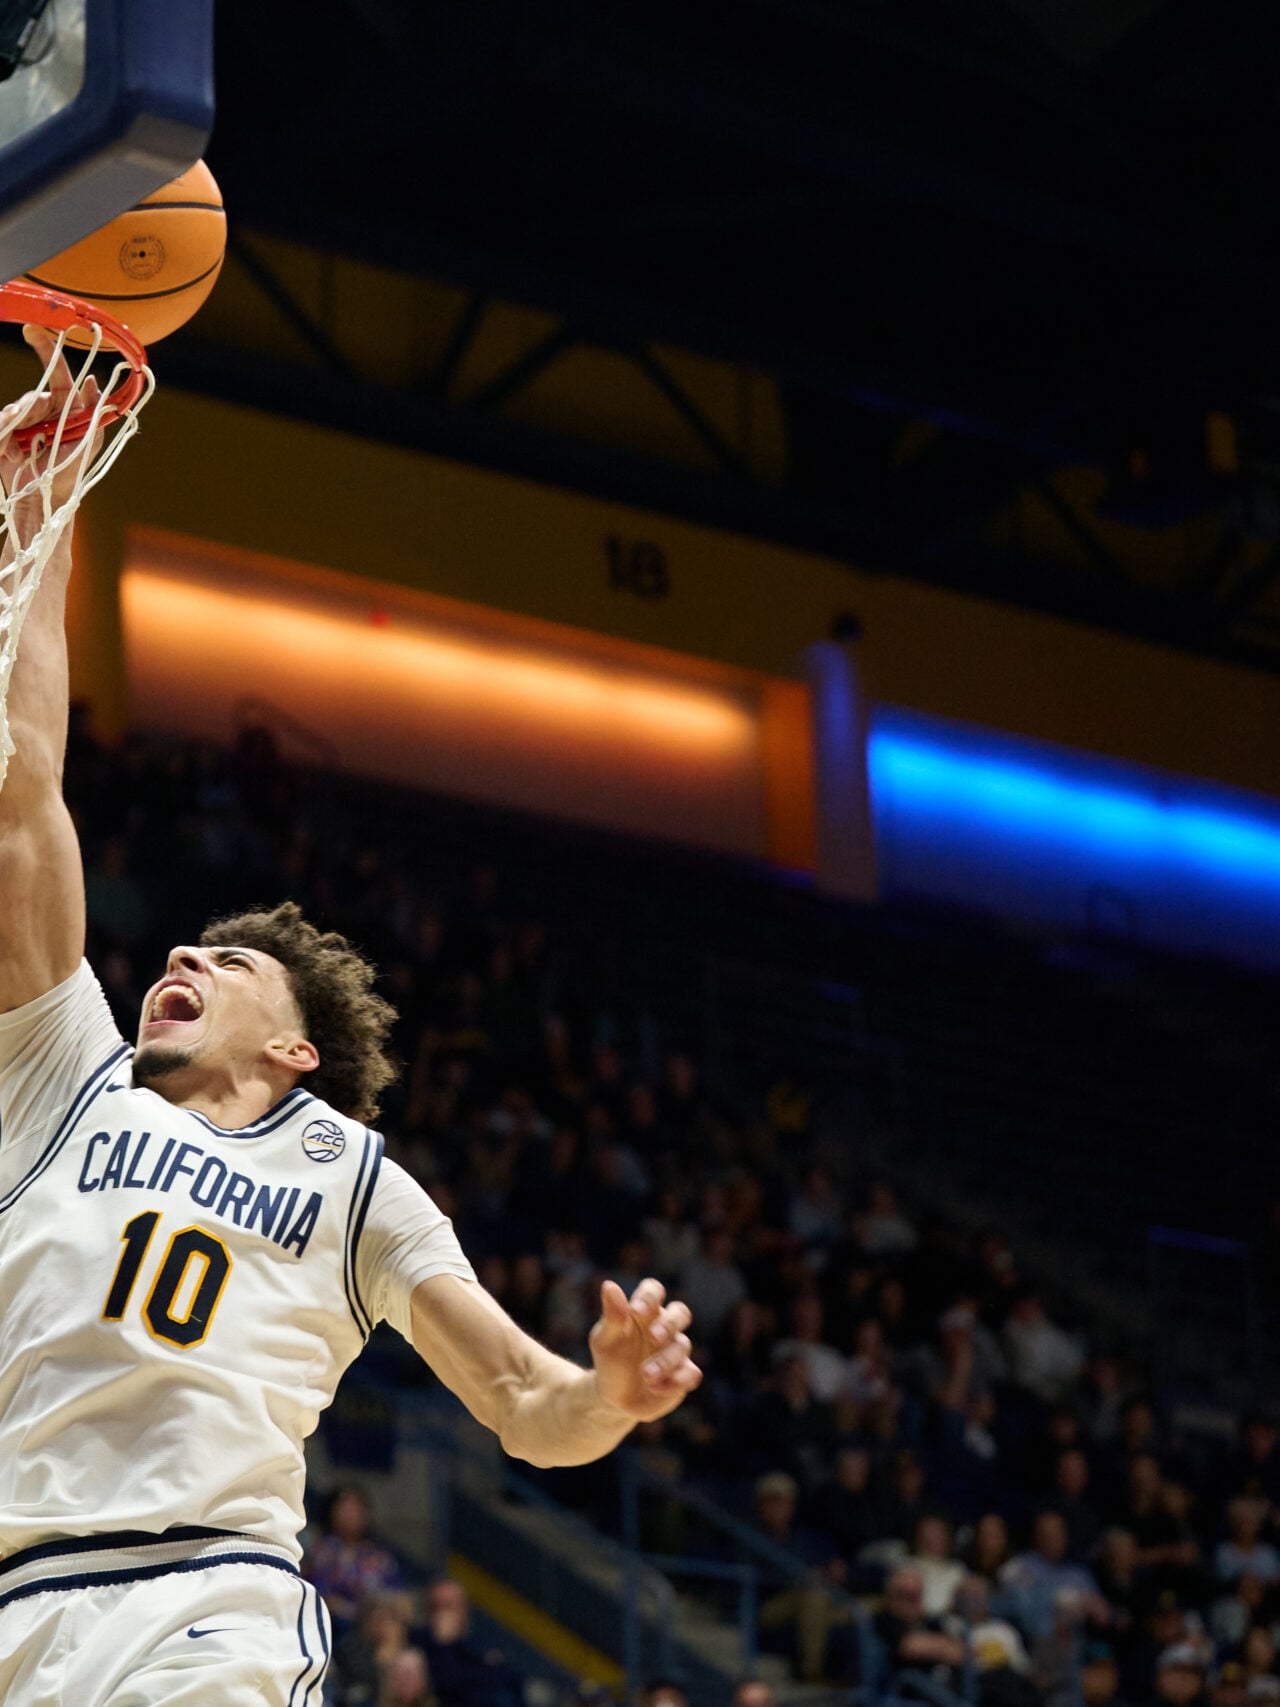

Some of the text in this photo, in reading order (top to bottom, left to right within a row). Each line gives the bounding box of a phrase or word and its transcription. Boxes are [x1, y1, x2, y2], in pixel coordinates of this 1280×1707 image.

[606, 534, 670, 599] 18
[307, 1132, 344, 1147] ACC
[78, 1130, 323, 1258] CALIFORNIA
[101, 1210, 233, 1350] 10
